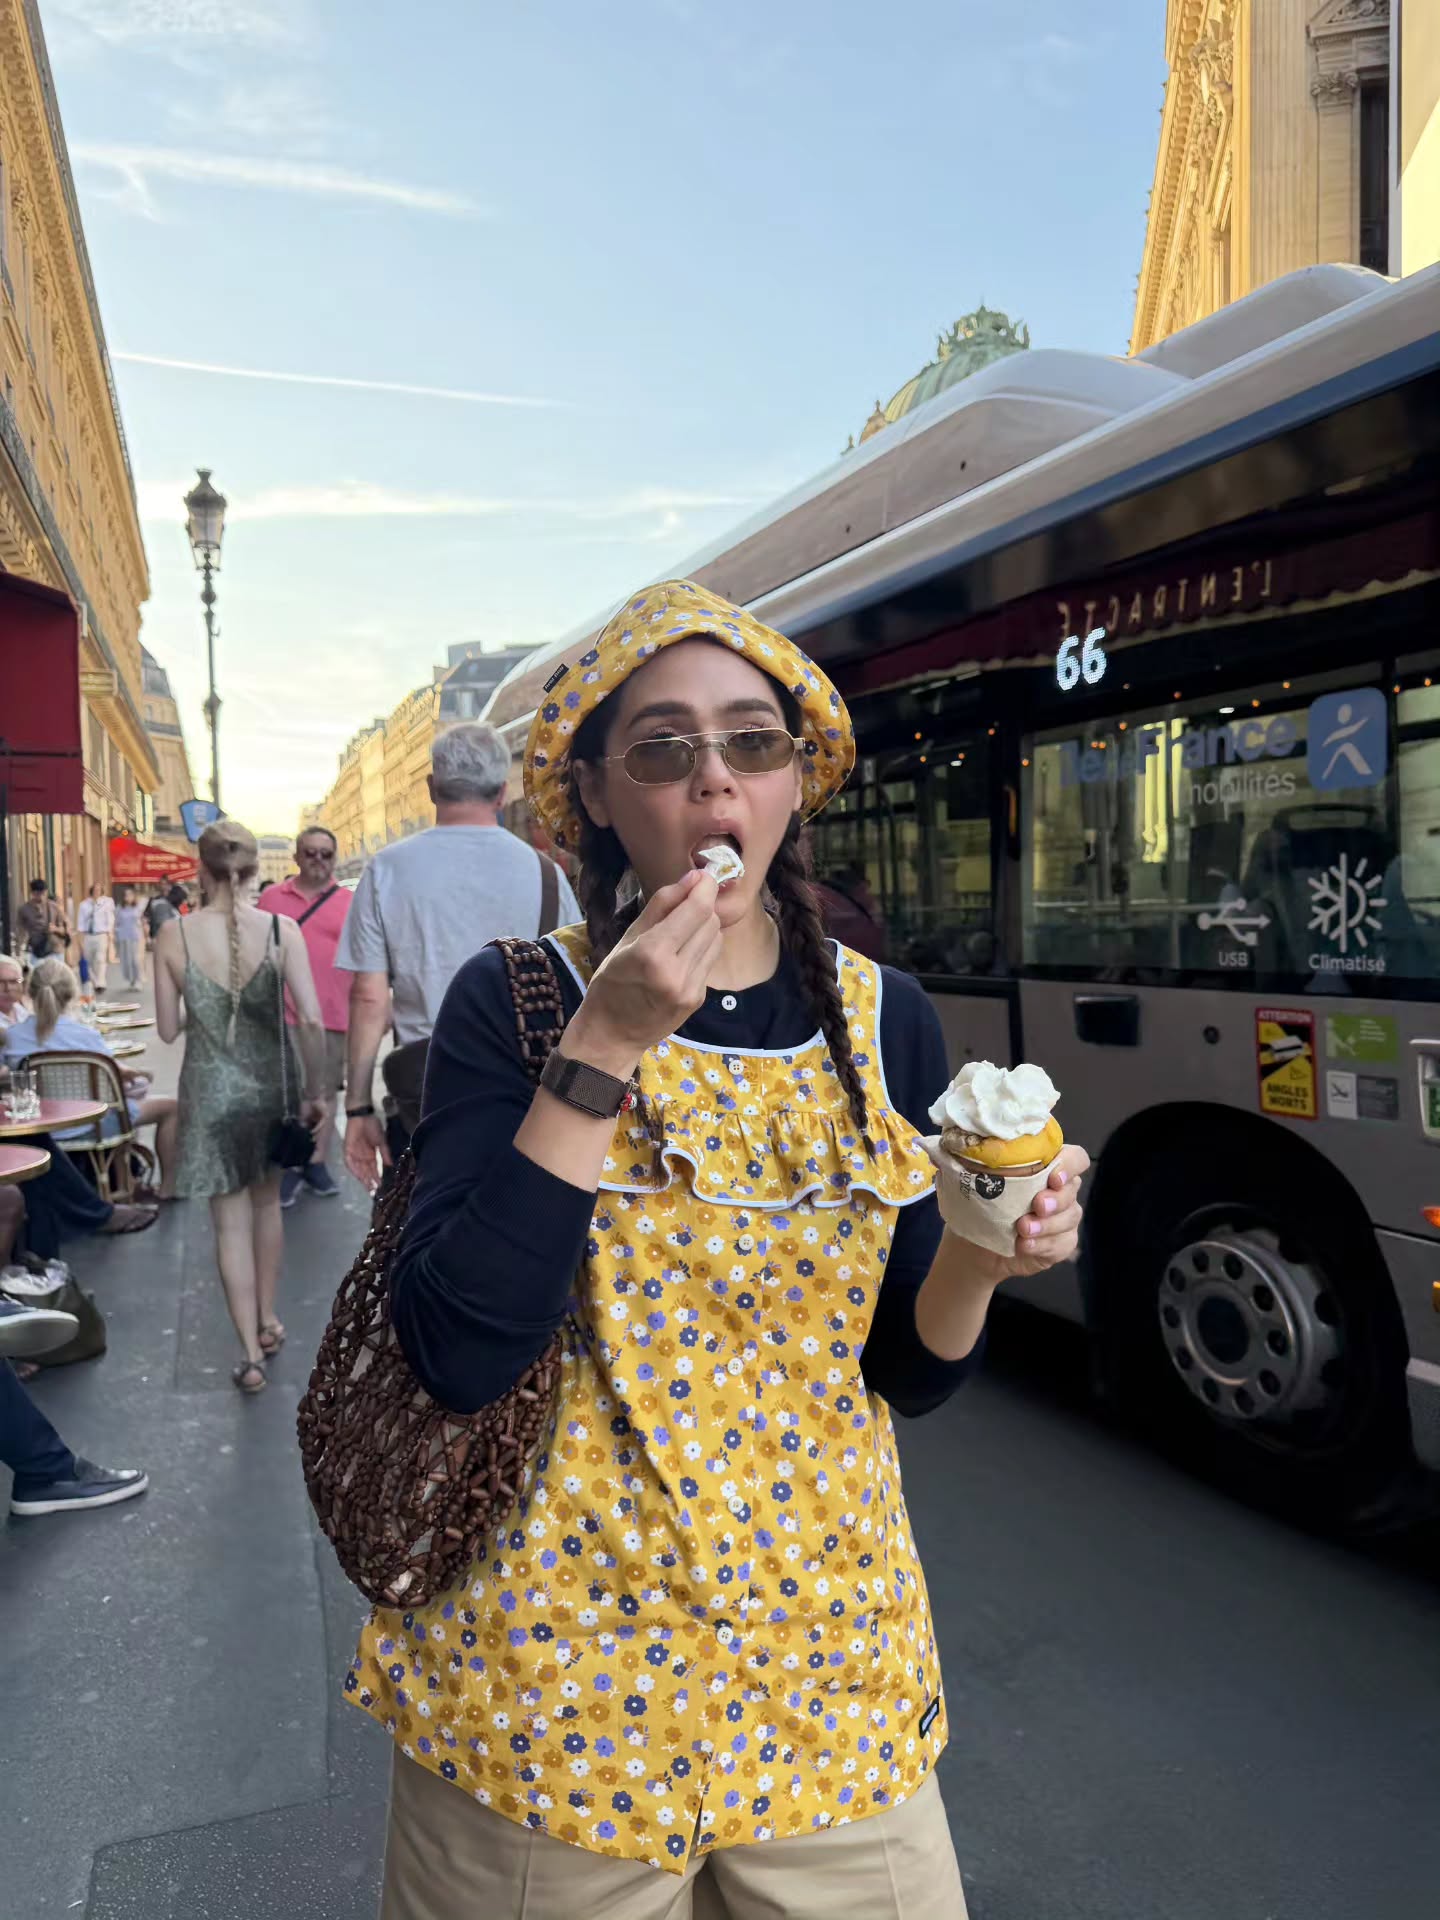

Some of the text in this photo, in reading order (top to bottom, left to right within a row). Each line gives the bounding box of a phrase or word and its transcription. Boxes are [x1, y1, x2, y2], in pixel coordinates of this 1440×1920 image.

[1056, 627, 1107, 691] 66
[1218, 951, 1249, 967] USB
[1308, 953, 1386, 973] Climatisé
[1267, 1082, 1309, 1098] ANGLES
